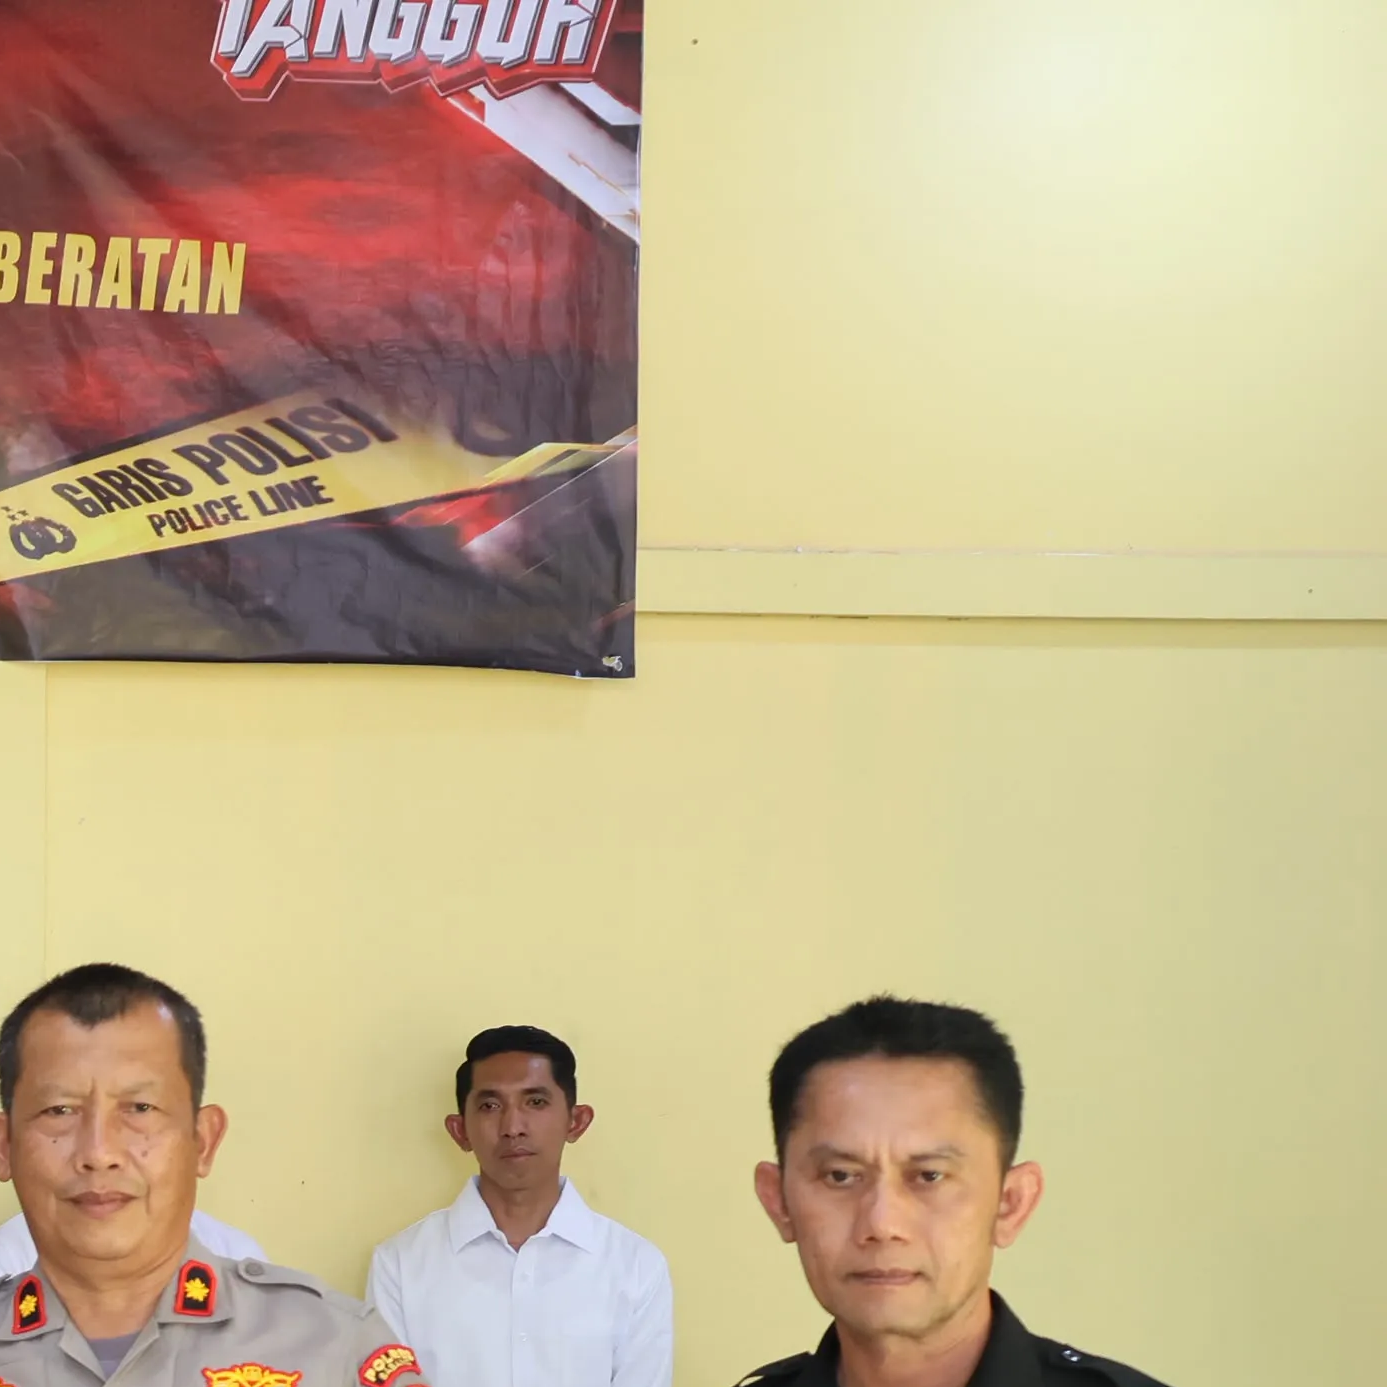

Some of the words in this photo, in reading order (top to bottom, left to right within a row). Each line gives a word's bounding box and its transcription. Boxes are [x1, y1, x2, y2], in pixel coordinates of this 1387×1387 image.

[51, 457, 194, 519] GARIS
[173, 397, 399, 487] POLISI
[146, 494, 249, 539] POLICE
[248, 476, 335, 517] LINE
